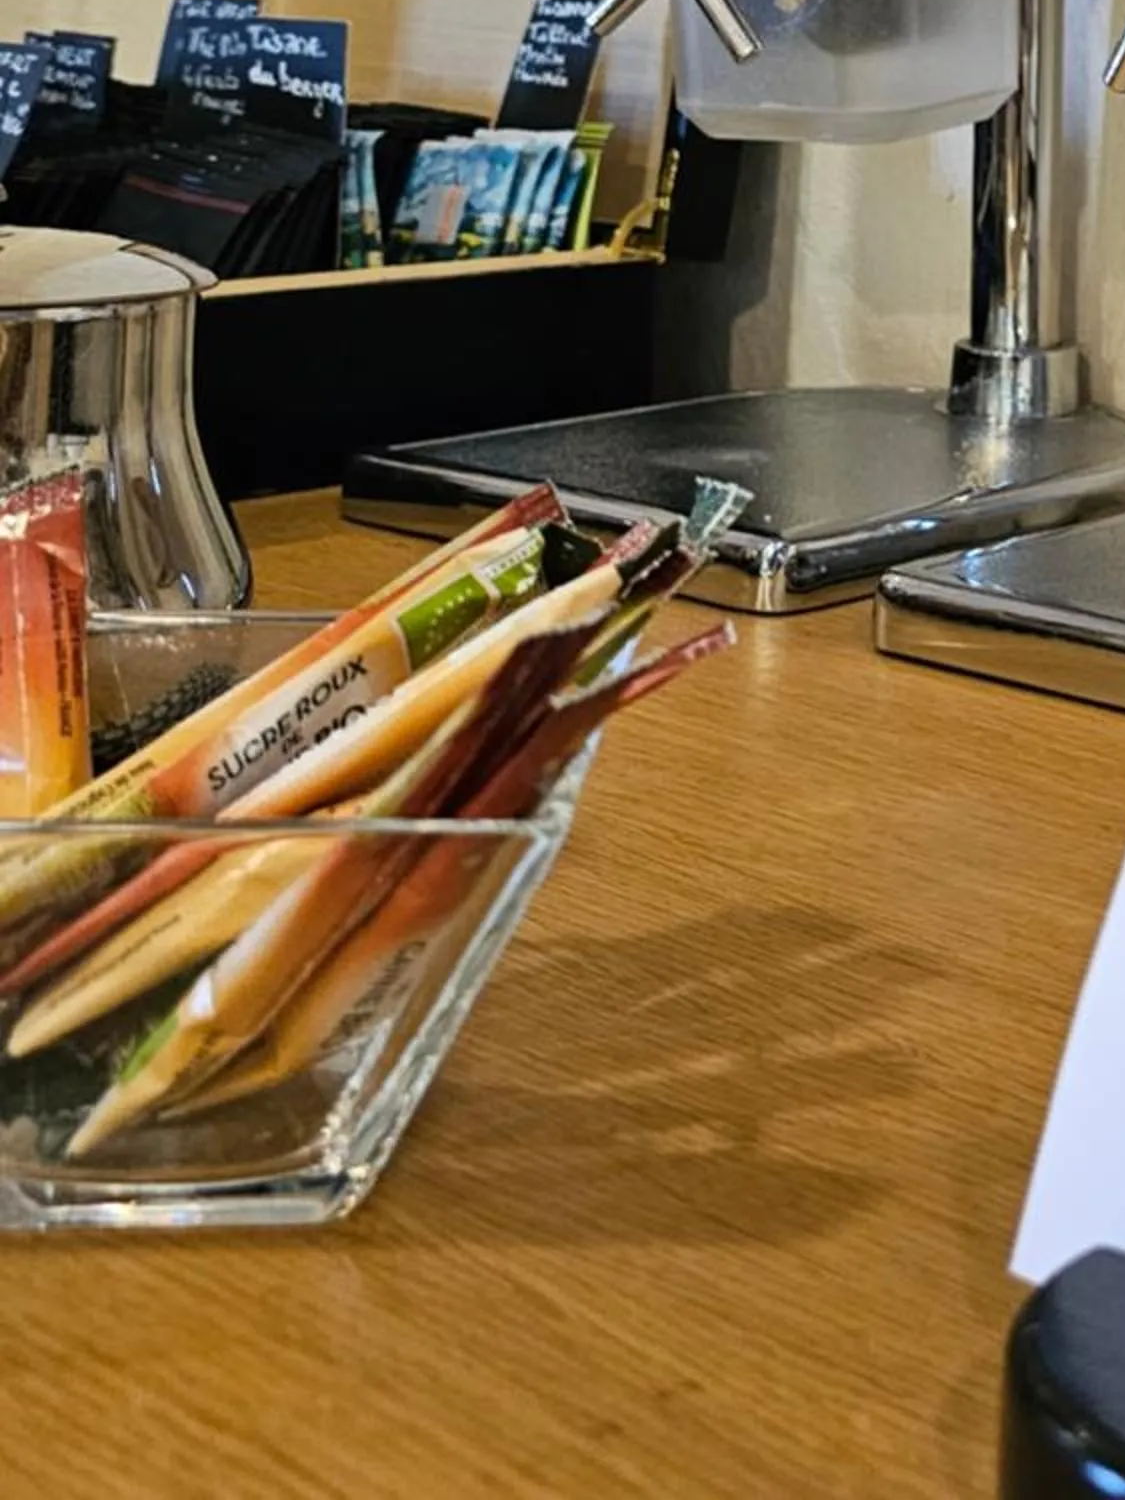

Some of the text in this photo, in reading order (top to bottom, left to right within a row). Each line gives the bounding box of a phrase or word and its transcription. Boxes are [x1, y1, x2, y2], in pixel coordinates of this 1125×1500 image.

[246, 23, 329, 58] Tisane
[247, 58, 278, 87] du
[207, 710, 293, 792] SUCRE
[294, 655, 368, 722] ROUX
